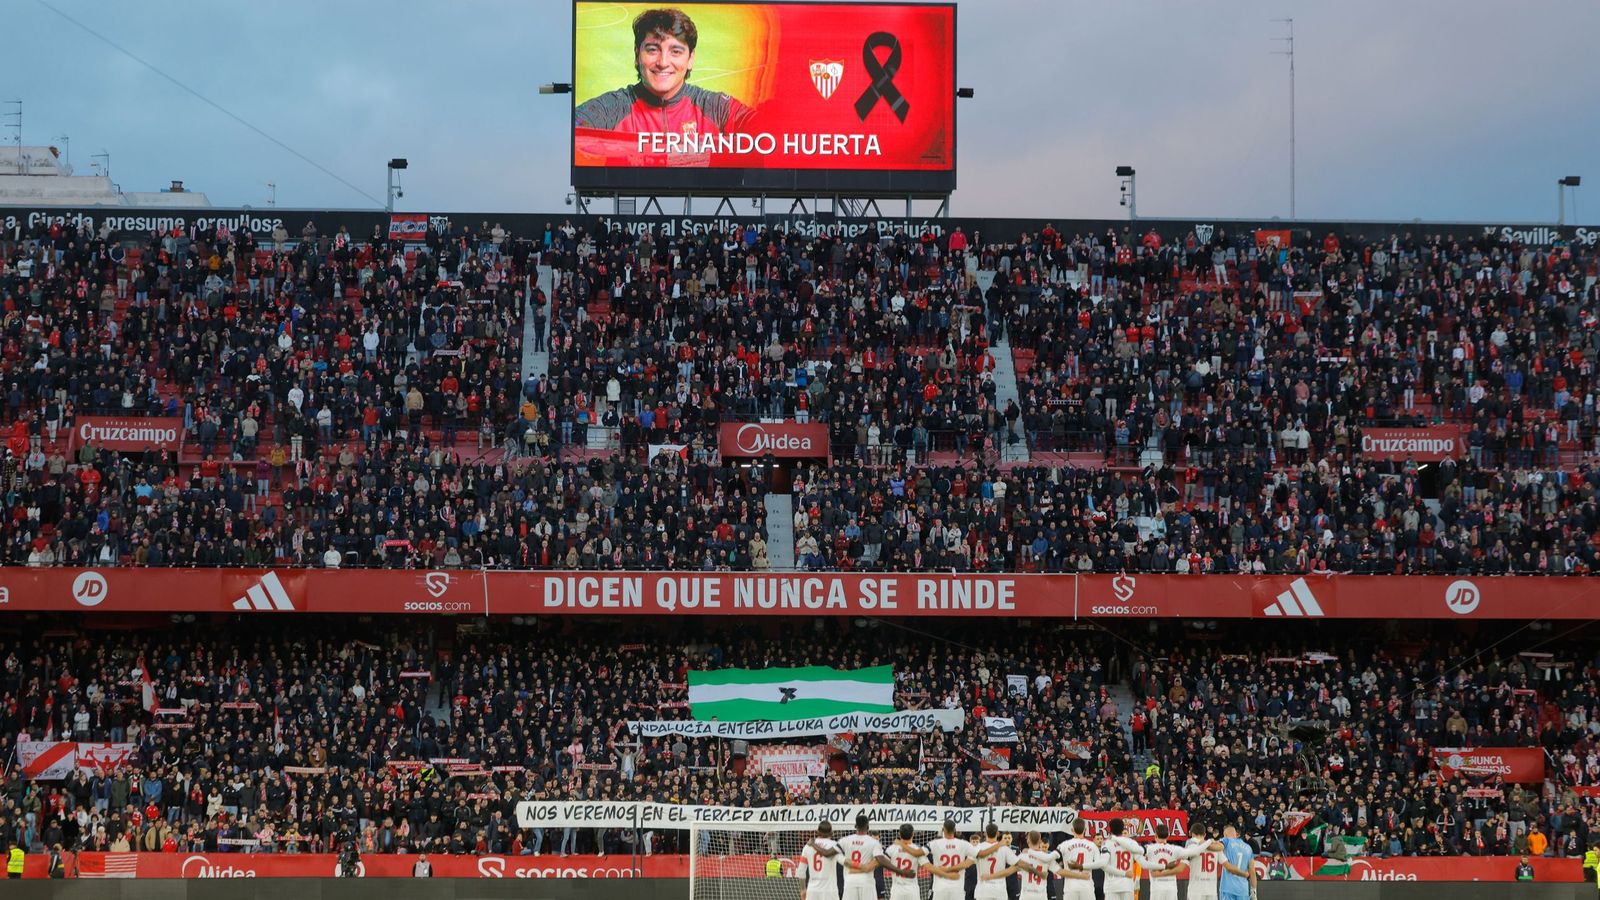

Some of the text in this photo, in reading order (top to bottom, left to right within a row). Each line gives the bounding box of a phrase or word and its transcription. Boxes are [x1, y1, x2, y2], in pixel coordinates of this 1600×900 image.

[637, 131, 882, 156] FERNANDO HUERTA
[28, 211, 94, 230] Girada
[627, 220, 656, 236] ver
[661, 218, 676, 236] al
[681, 218, 740, 237] Sevlla
[1500, 226, 1560, 245] Sevilla
[1575, 227, 1600, 246] Se
[80, 422, 176, 445] Cruzcampo
[752, 433, 812, 450] Midea
[1361, 434, 1454, 455] Cruzcampo
[77, 580, 103, 598] JD
[544, 577, 1016, 611] DICEN QUE NUNCA SE RINDE
[1450, 588, 1475, 605] JD
[631, 713, 935, 735] ANDALUCÍA ENTERA LLORA CON VOSOTROS
[525, 805, 558, 821] NOS
[563, 804, 636, 821] VEREMOS
[642, 806, 663, 821] EN
[668, 807, 687, 821] EL
[694, 808, 754, 822] TERCER
[943, 809, 974, 824] POR
[1001, 809, 1076, 825] FERNANDO
[813, 852, 823, 873] 6
[987, 857, 997, 875] 7
[1076, 852, 1085, 872] 4
[1115, 850, 1131, 871] 18
[1199, 851, 1215, 873] 16
[1236, 852, 1243, 869] 1
[199, 865, 256, 878] Midea
[1361, 868, 1417, 881] Midea
